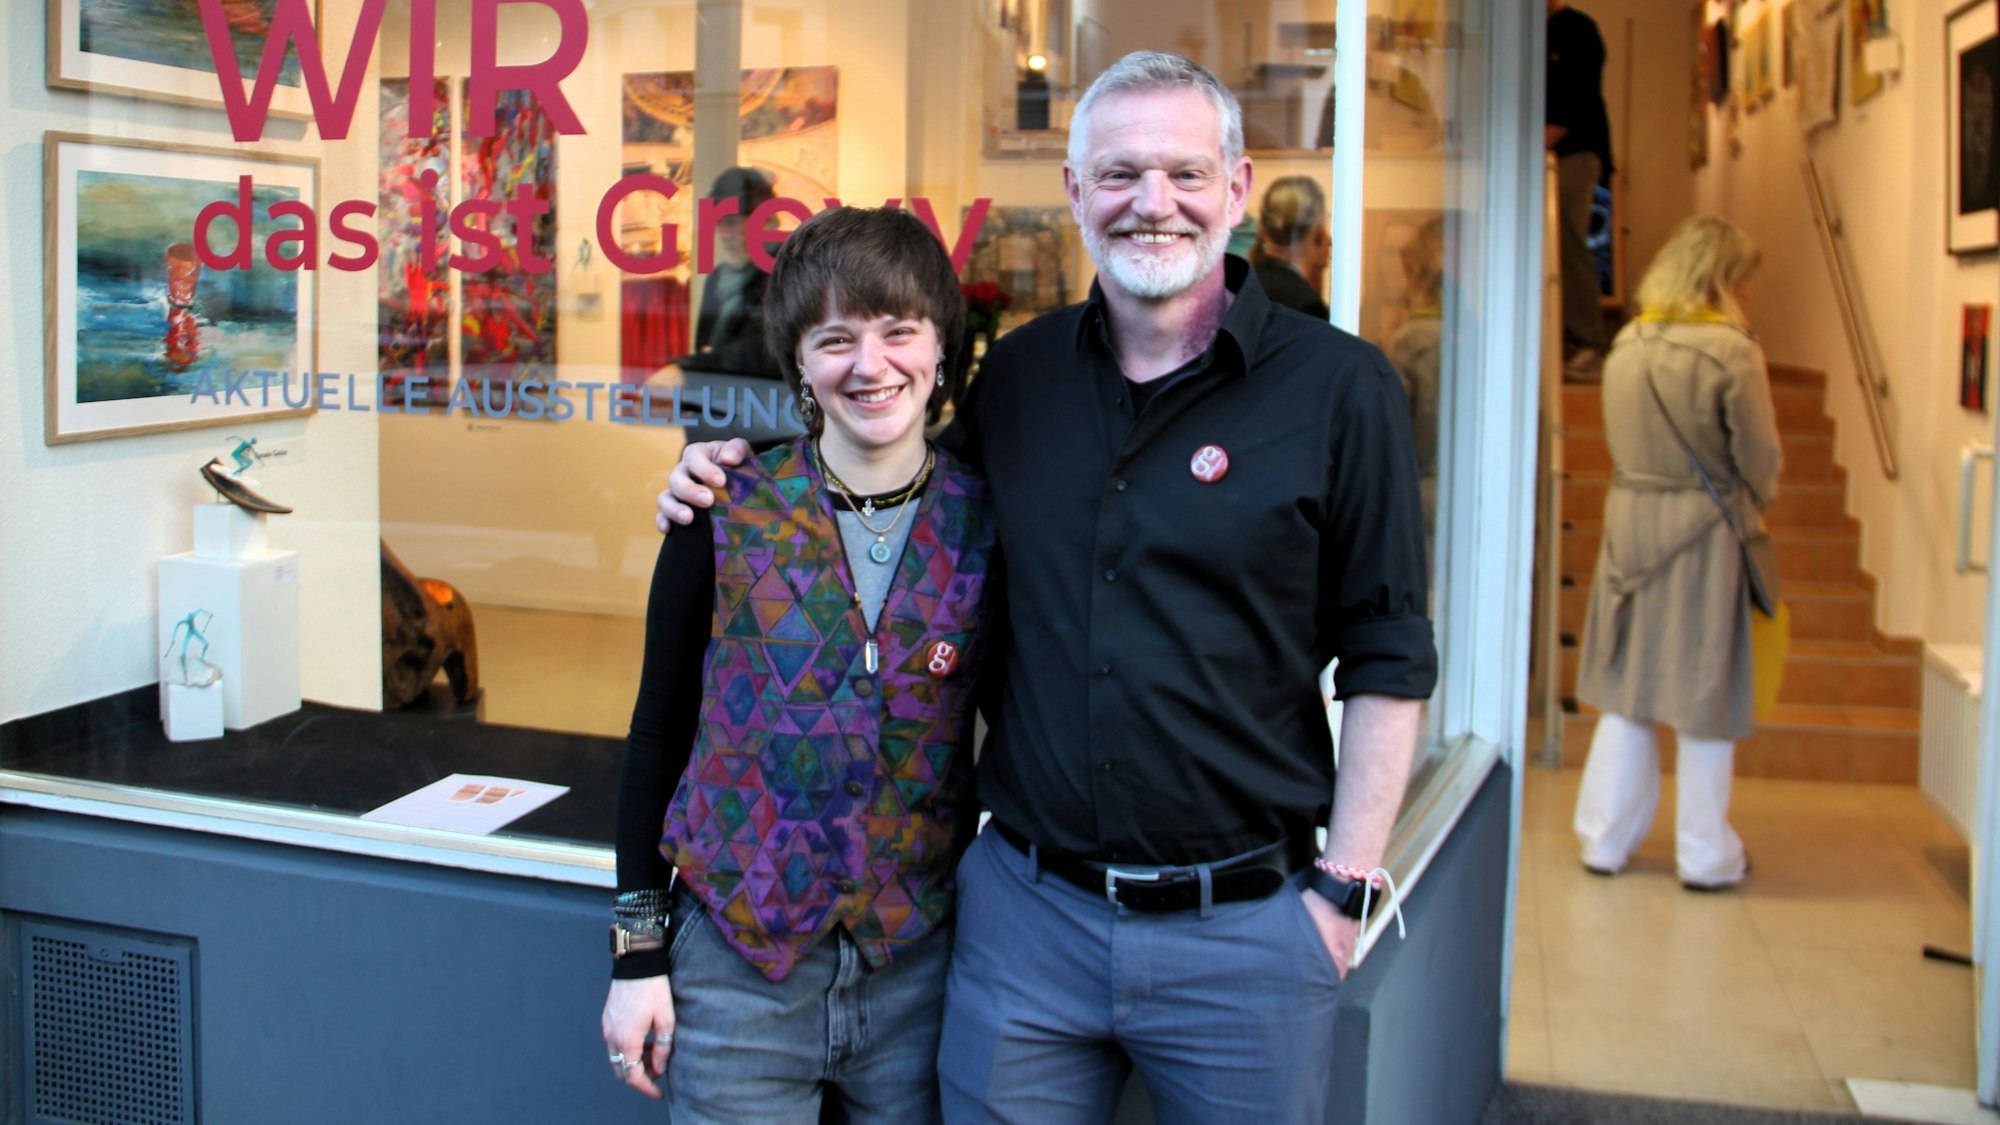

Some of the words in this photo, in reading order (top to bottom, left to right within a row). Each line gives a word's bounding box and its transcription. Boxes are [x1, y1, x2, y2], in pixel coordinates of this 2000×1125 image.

[199, 0, 589, 142] WIR
[193, 175, 379, 271] das
[418, 168, 551, 274] ist
[190, 369, 430, 414] AKTUELLE
